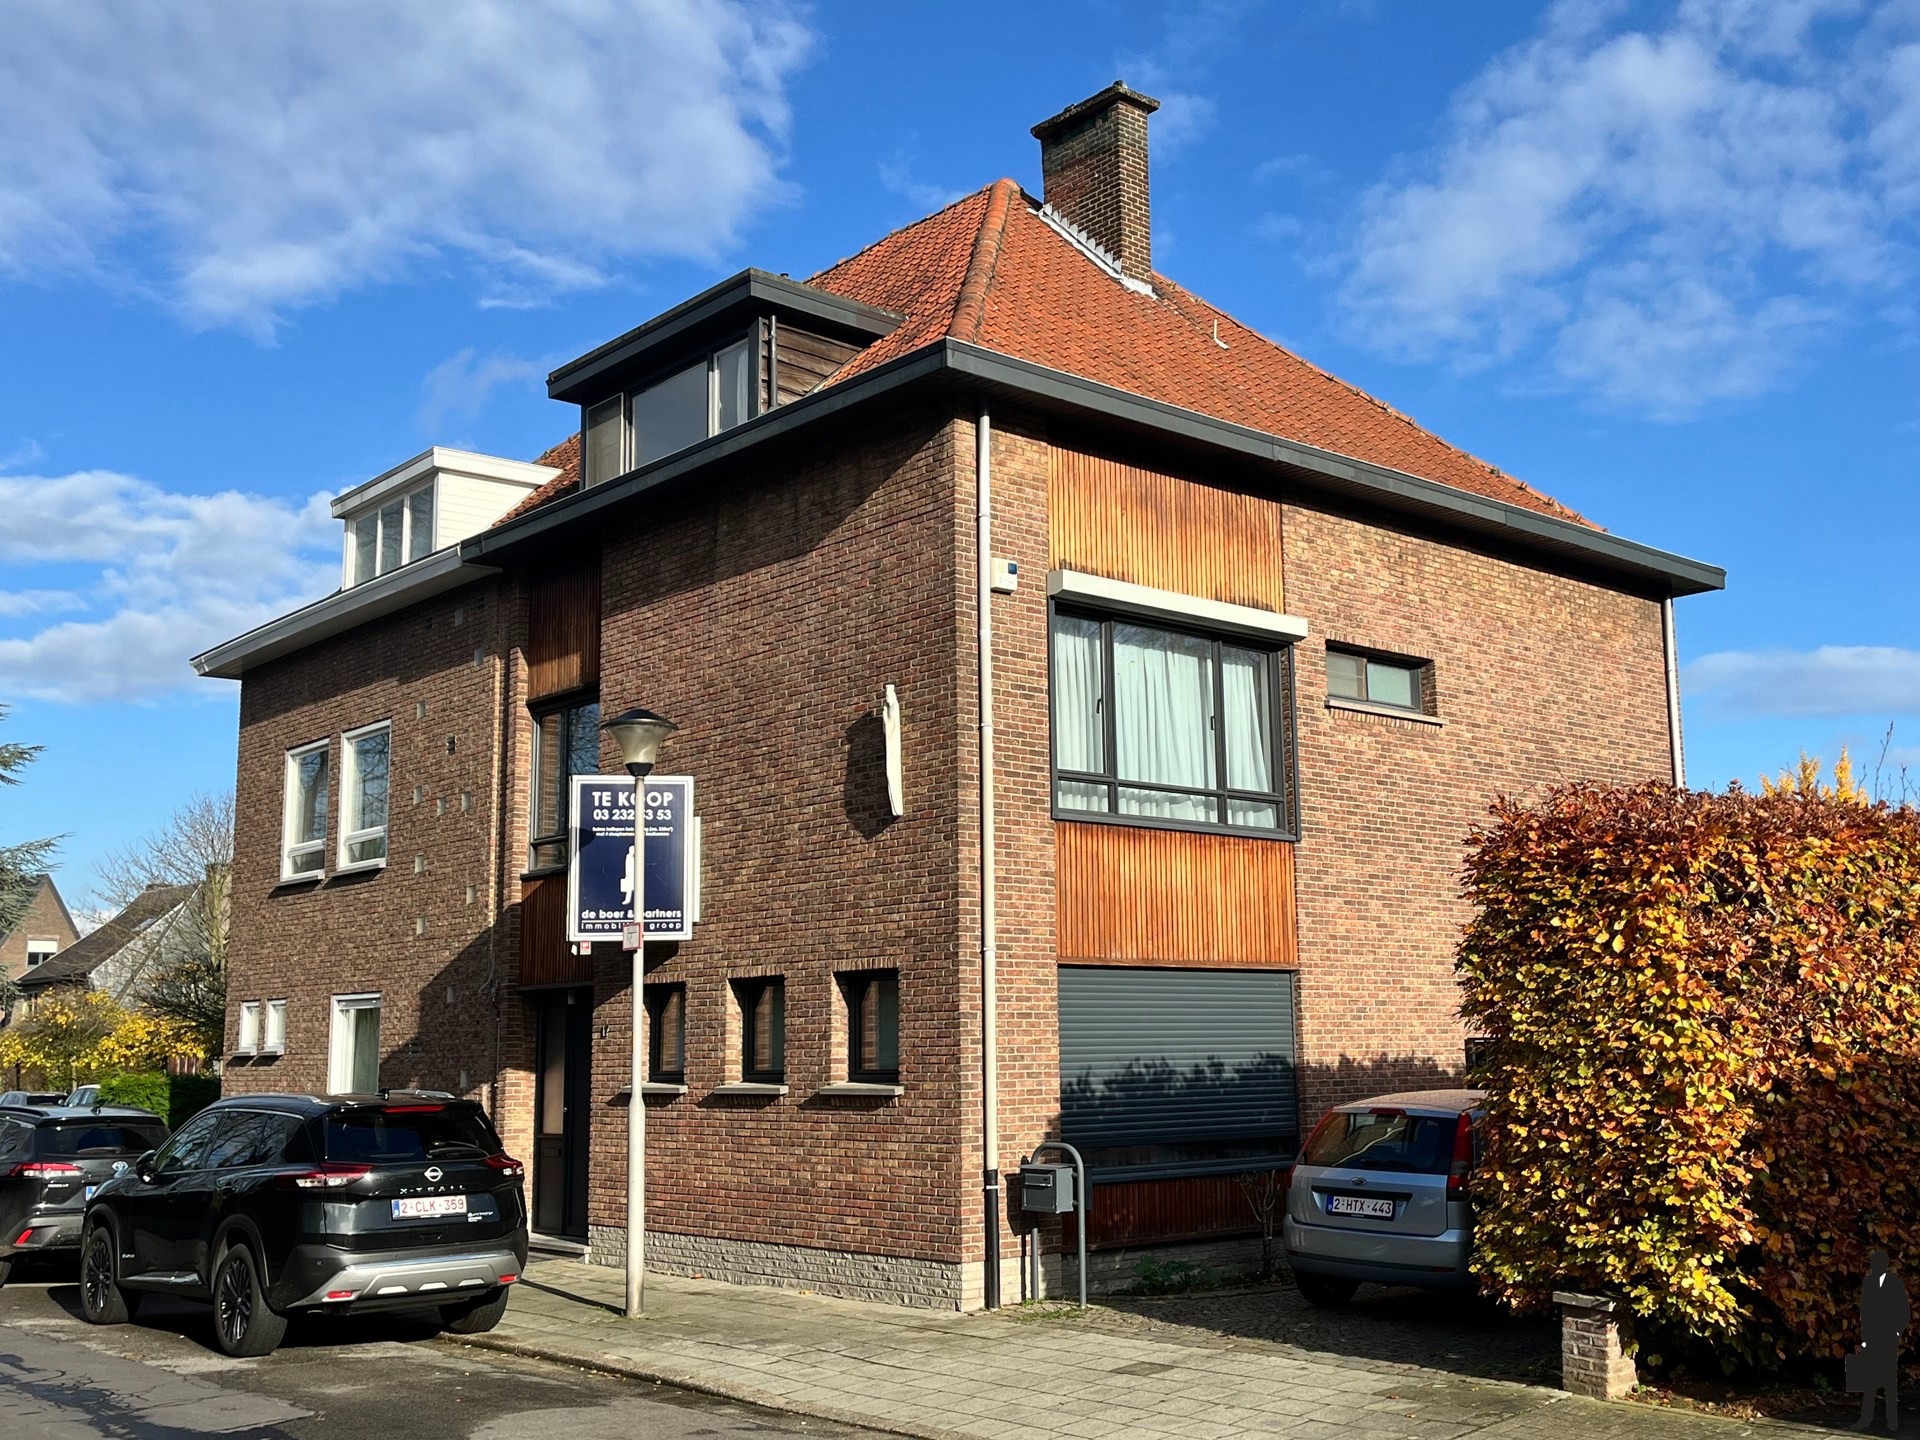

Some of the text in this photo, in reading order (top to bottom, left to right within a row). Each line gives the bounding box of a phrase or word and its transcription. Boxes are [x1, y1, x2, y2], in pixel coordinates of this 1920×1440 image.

[592, 791, 612, 807] TE
[593, 809, 609, 820] 03
[612, 809, 635, 820] 232
[656, 809, 672, 820] 53
[581, 909, 681, 919] de boer & artners
[400, 1185, 465, 1194] X-TRAIL
